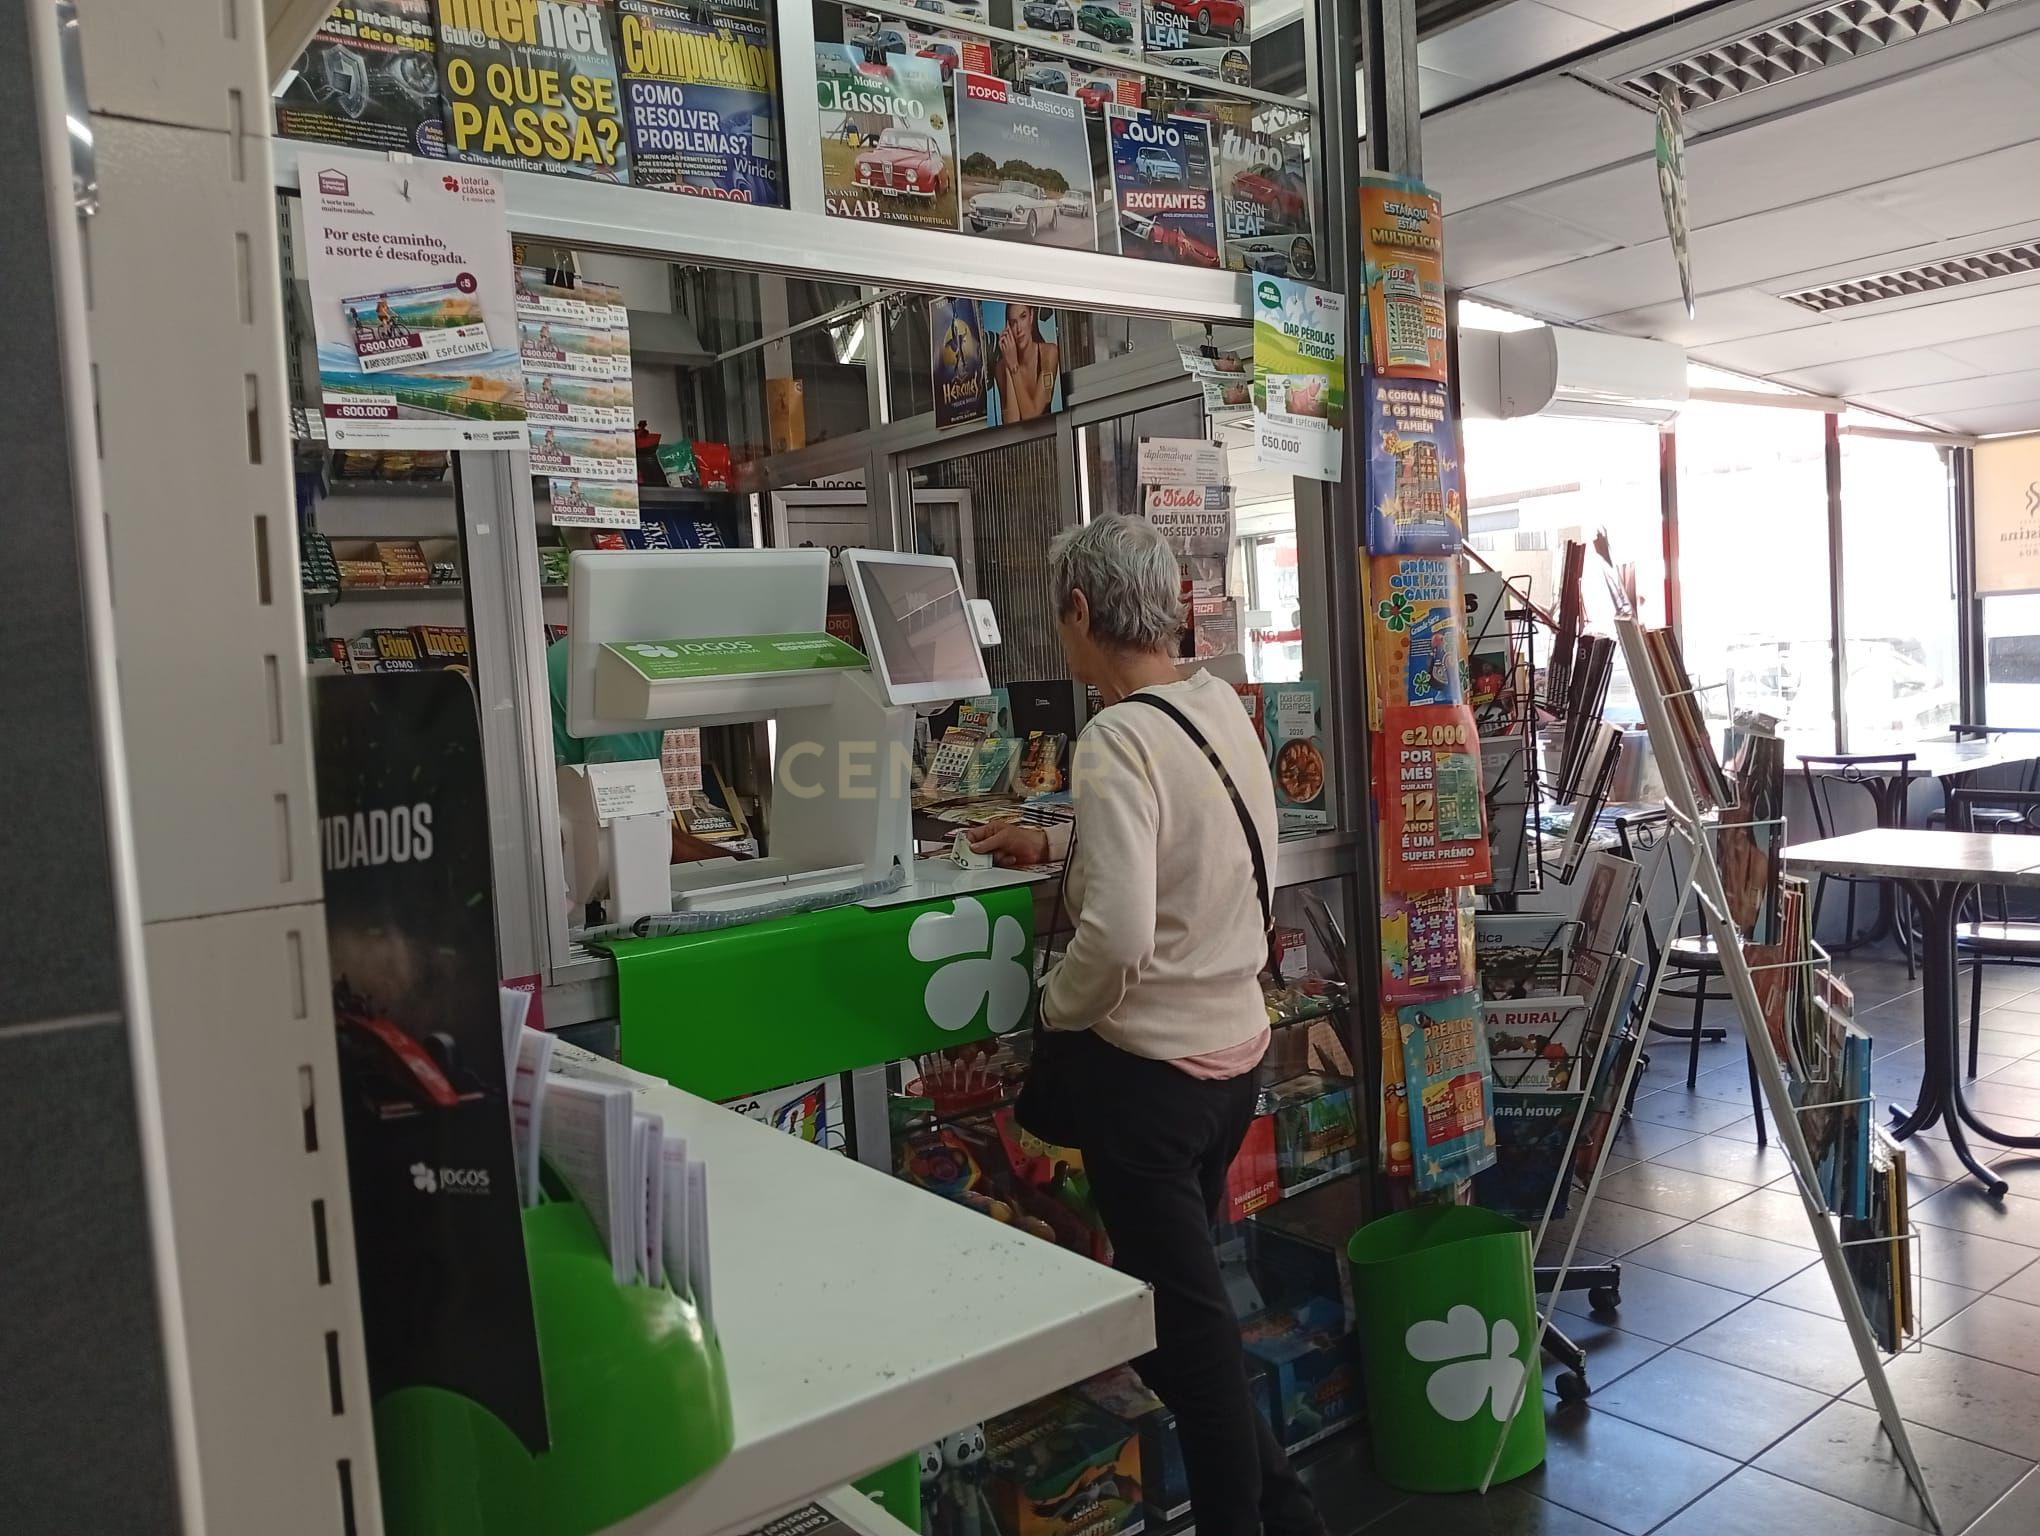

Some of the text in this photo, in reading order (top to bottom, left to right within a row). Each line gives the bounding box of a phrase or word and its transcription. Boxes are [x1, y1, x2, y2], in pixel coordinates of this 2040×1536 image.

[1144, 12, 1189, 29] NISSAN
[359, 26, 382, 40] de
[382, 31, 394, 43] o
[1144, 27, 1189, 49] LEAF
[447, 58, 476, 97] O
[486, 63, 563, 108] QUE
[570, 74, 617, 115] SE
[854, 76, 883, 89] Motor
[631, 84, 683, 106] COMO
[817, 80, 924, 119] Clássico
[967, 85, 1075, 119] TOPOS & CLÁSSICOS
[634, 107, 720, 131] RESOLVER
[452, 101, 619, 166] PASSA?
[1013, 123, 1039, 138] MGC
[637, 129, 748, 155] PROBLEMAS?
[545, 162, 568, 174] tudo
[461, 176, 489, 186] lotaria
[462, 185, 495, 195] clássica
[826, 199, 881, 219] SAAB
[1126, 192, 1206, 210] EXCITANTES
[1224, 200, 1265, 215] NISSAN
[892, 213, 909, 221] ANOS
[920, 215, 953, 225] PORTUGAL
[1225, 214, 1265, 234] LEAF
[323, 227, 447, 250] Por este caminho,
[325, 246, 467, 266] a sorte é desafogada.
[1284, 322, 1335, 346] DAR PÉROLAS
[436, 341, 489, 358] ESPÉCIMEN
[1306, 343, 1335, 361] PORCOS
[1376, 388, 1387, 400] A
[1388, 389, 1420, 402] COROA
[1429, 393, 1445, 407] SUA
[1393, 406, 1407, 417] OS
[1410, 406, 1444, 421] PRÉMIOS
[1295, 417, 1326, 430] ESPÉCIMEN
[1396, 420, 1434, 433] TAMBÉM
[1144, 450, 1192, 462] diplomatique
[1163, 488, 1202, 507] Diabo
[1152, 514, 1227, 525] QUEM VAI TRATAR
[1176, 527, 1198, 537] SEUS
[1200, 527, 1224, 538] PAIS?
[1400, 559, 1448, 573] PRÉMIO
[1390, 575, 1419, 587] QUE
[677, 641, 753, 655] JOGOS
[385, 661, 413, 669] COMO
[1402, 725, 1466, 746] €2.000
[1401, 751, 1432, 763] POR
[1401, 764, 1433, 780] MÊS
[1402, 793, 1434, 821] 12
[690, 822, 732, 831] BONAPARTE
[1402, 822, 1434, 833] ANOS
[1402, 834, 1434, 848] É UM
[1402, 846, 1474, 861] SUPER PRÉMIO
[1505, 1012, 1561, 1025] RURAL
[1426, 1058, 1442, 1077] DE
